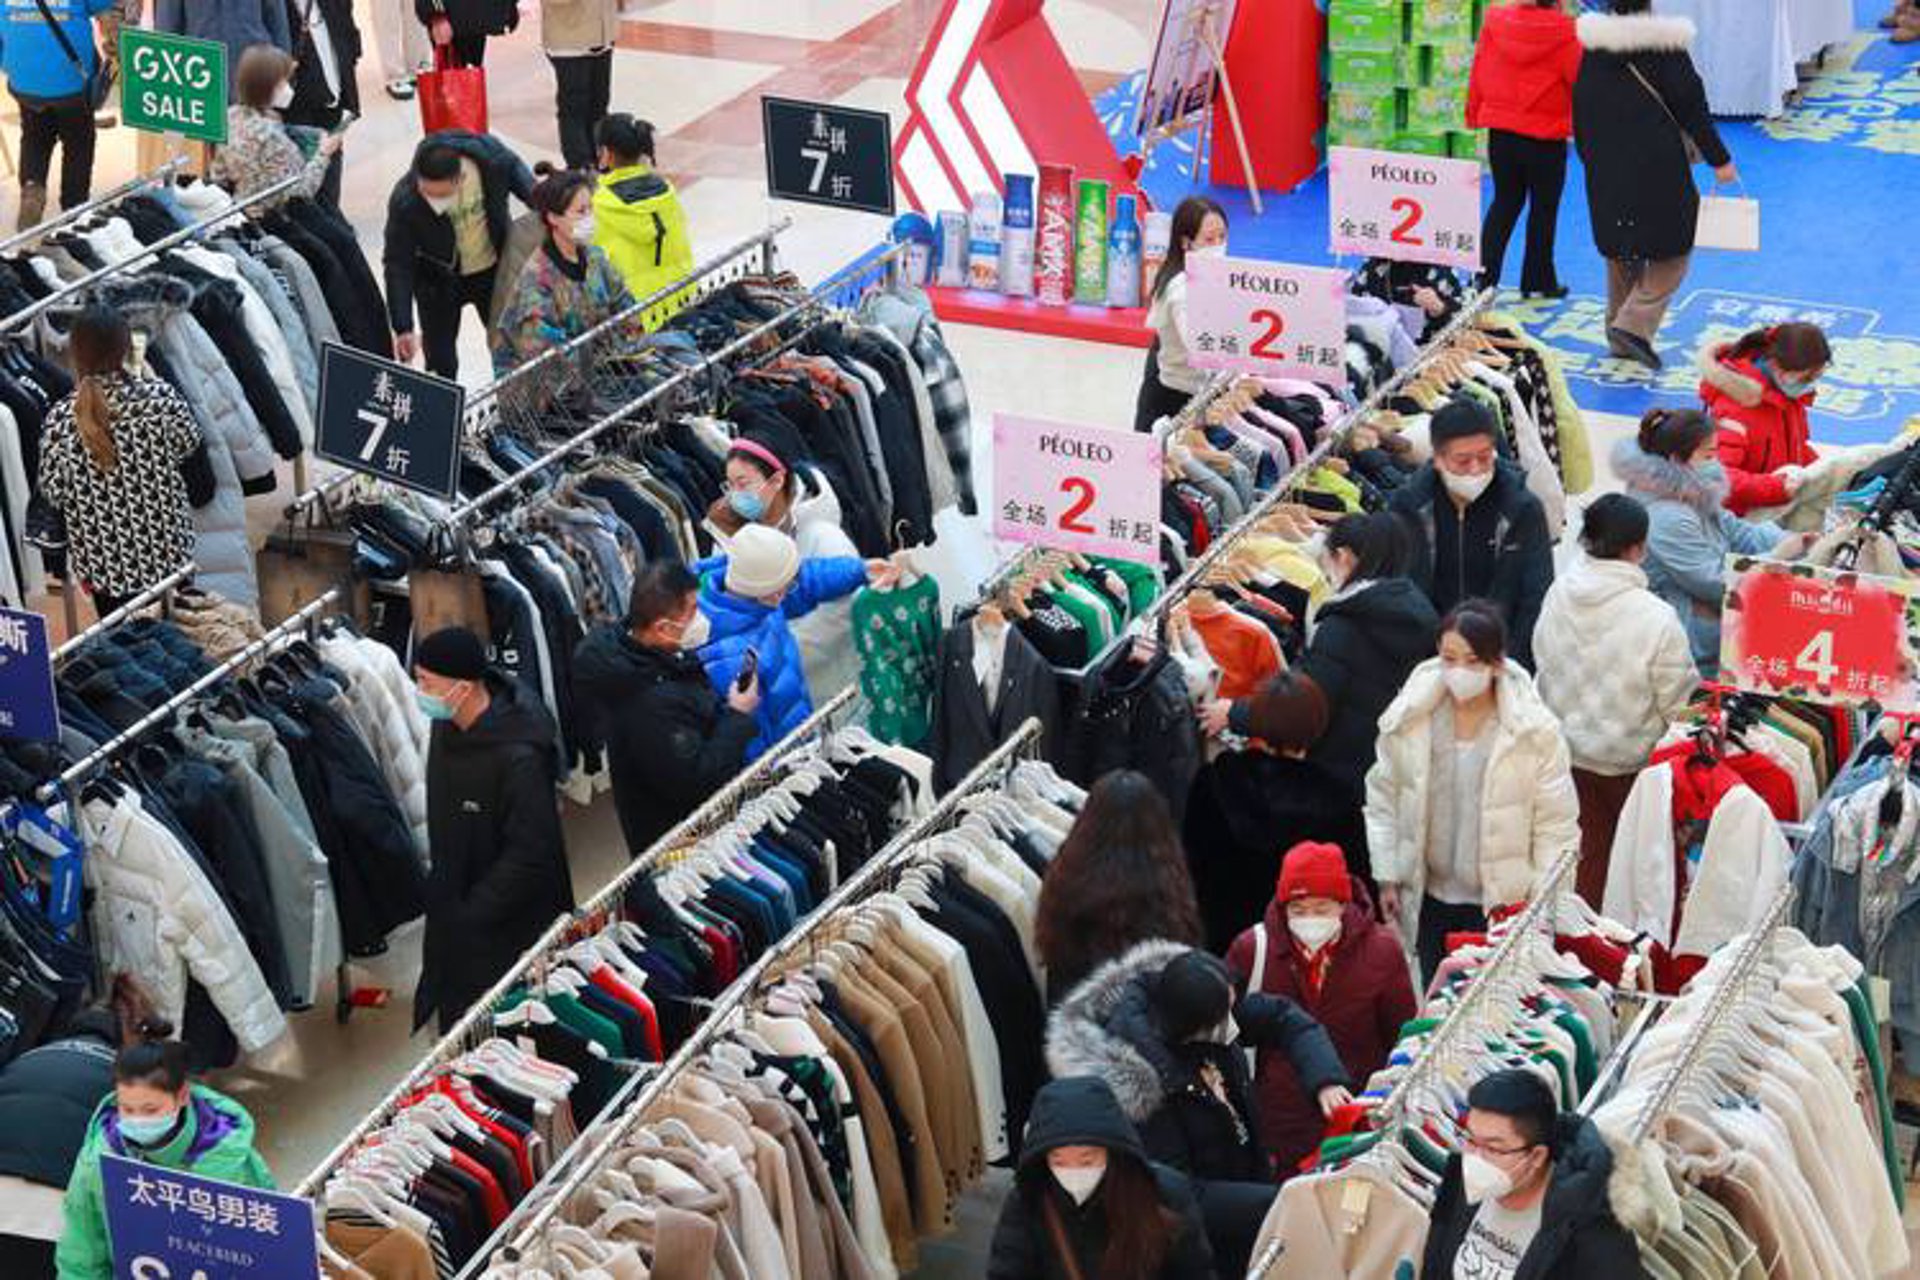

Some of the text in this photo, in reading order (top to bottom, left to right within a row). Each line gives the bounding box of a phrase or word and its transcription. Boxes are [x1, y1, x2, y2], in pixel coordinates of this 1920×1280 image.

[133, 46, 211, 90] GXG
[142, 91, 206, 126] SALE
[1371, 164, 1438, 185] PÉOLEO
[1391, 198, 1424, 246] 2
[1229, 271, 1299, 296] PÉOLEO
[1196, 308, 1340, 367] 全场 2 折起
[1039, 432, 1113, 464] PÉOLEO
[1002, 476, 1153, 545] 全场 2 折起
[1796, 630, 1840, 684] 4
[127, 1172, 281, 1236] 太平鸟男装
